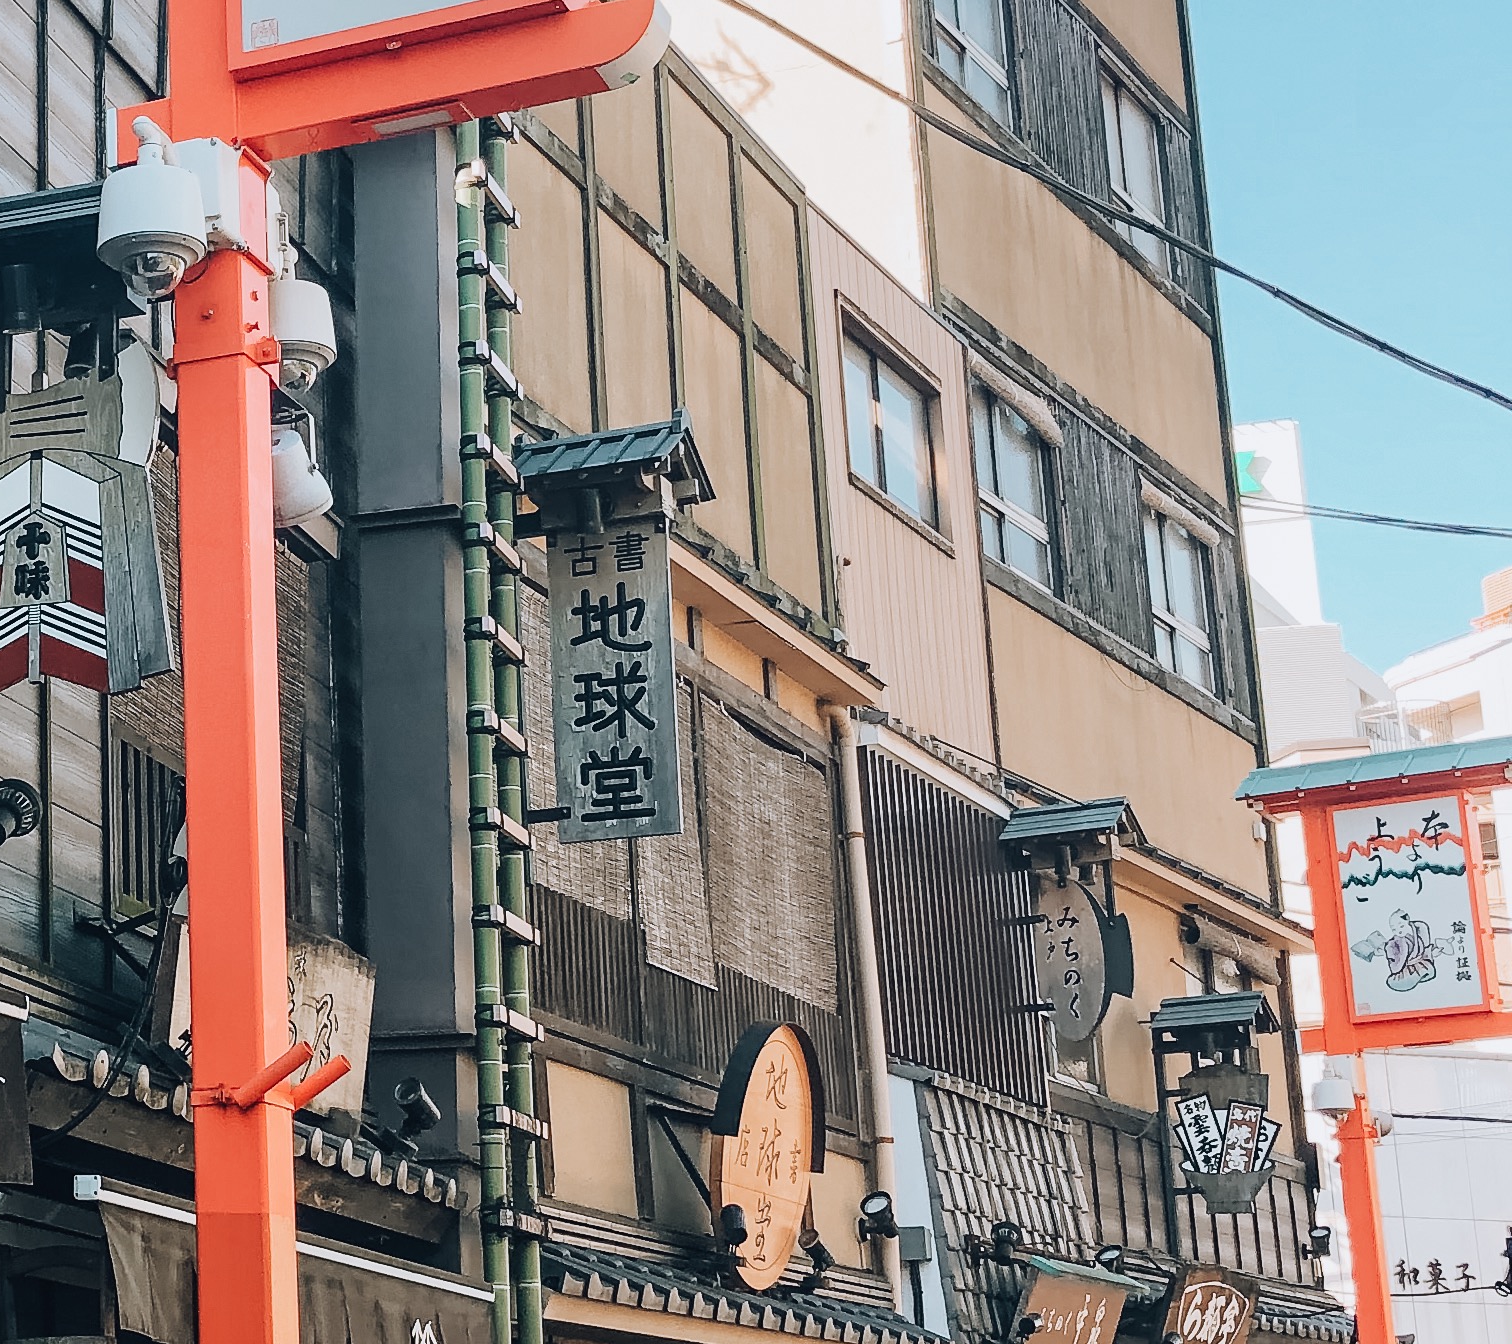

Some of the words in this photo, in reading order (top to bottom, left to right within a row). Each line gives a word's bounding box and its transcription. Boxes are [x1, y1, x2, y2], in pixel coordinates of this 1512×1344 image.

[564, 531, 650, 577] 古書
[570, 581, 657, 824] 地球堂
[1057, 906, 1080, 1019] みちのく
[1394, 1258, 1476, 1292] 和菓子
